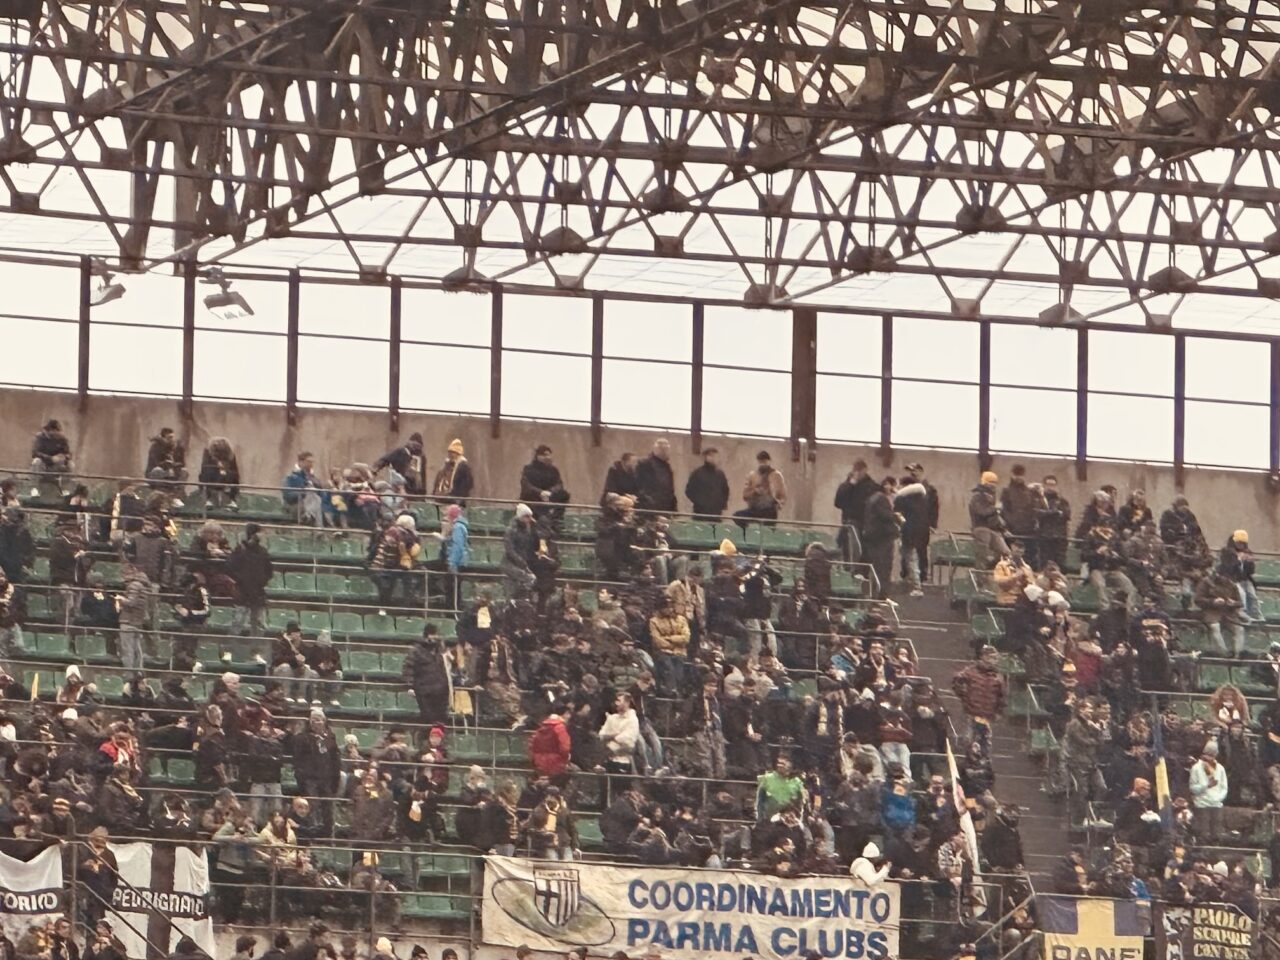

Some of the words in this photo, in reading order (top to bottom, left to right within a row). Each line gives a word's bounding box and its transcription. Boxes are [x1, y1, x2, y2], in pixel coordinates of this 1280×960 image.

[627, 879, 891, 923] COORDINAMENTO
[1193, 908, 1252, 931] PAOLO
[627, 918, 759, 954] PARMA
[771, 926, 889, 959] CLUBS
